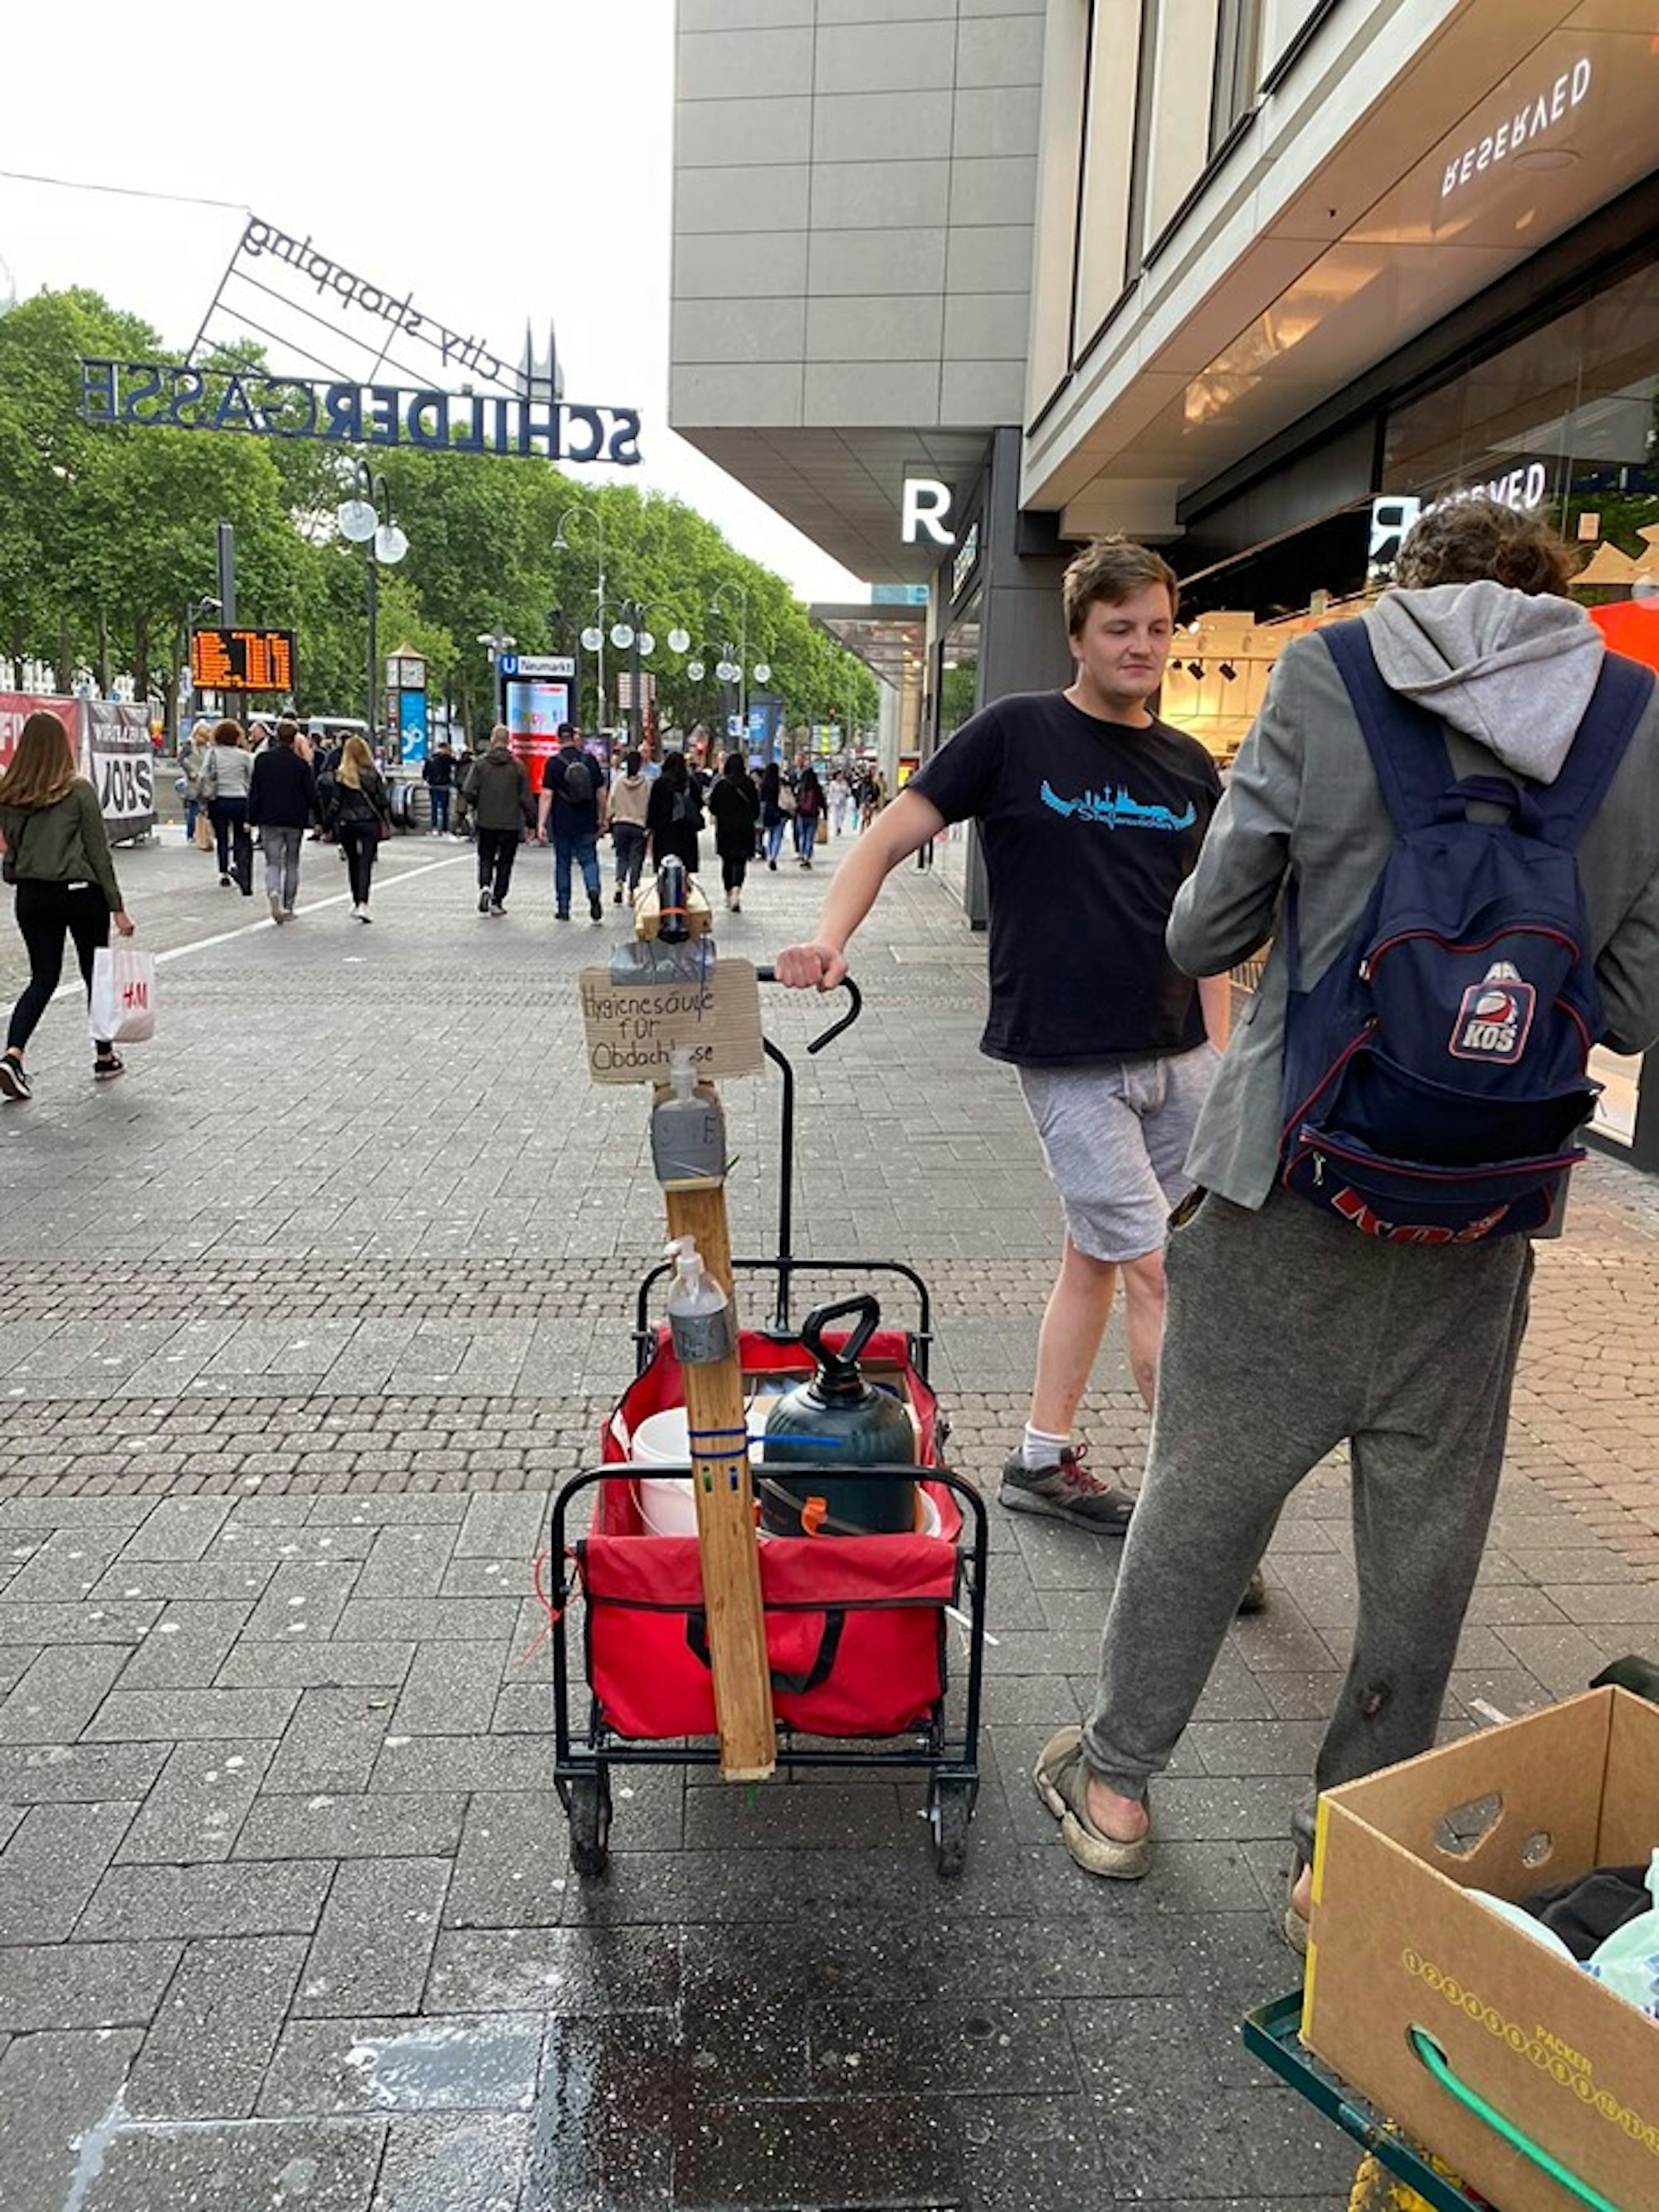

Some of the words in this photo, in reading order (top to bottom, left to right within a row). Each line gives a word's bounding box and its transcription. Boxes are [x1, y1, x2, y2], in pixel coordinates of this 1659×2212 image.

[902, 478, 956, 545] R
[503, 656, 516, 674] U
[102, 760, 153, 812] JOBS
[1536, 2024, 1593, 2077] PACKER
